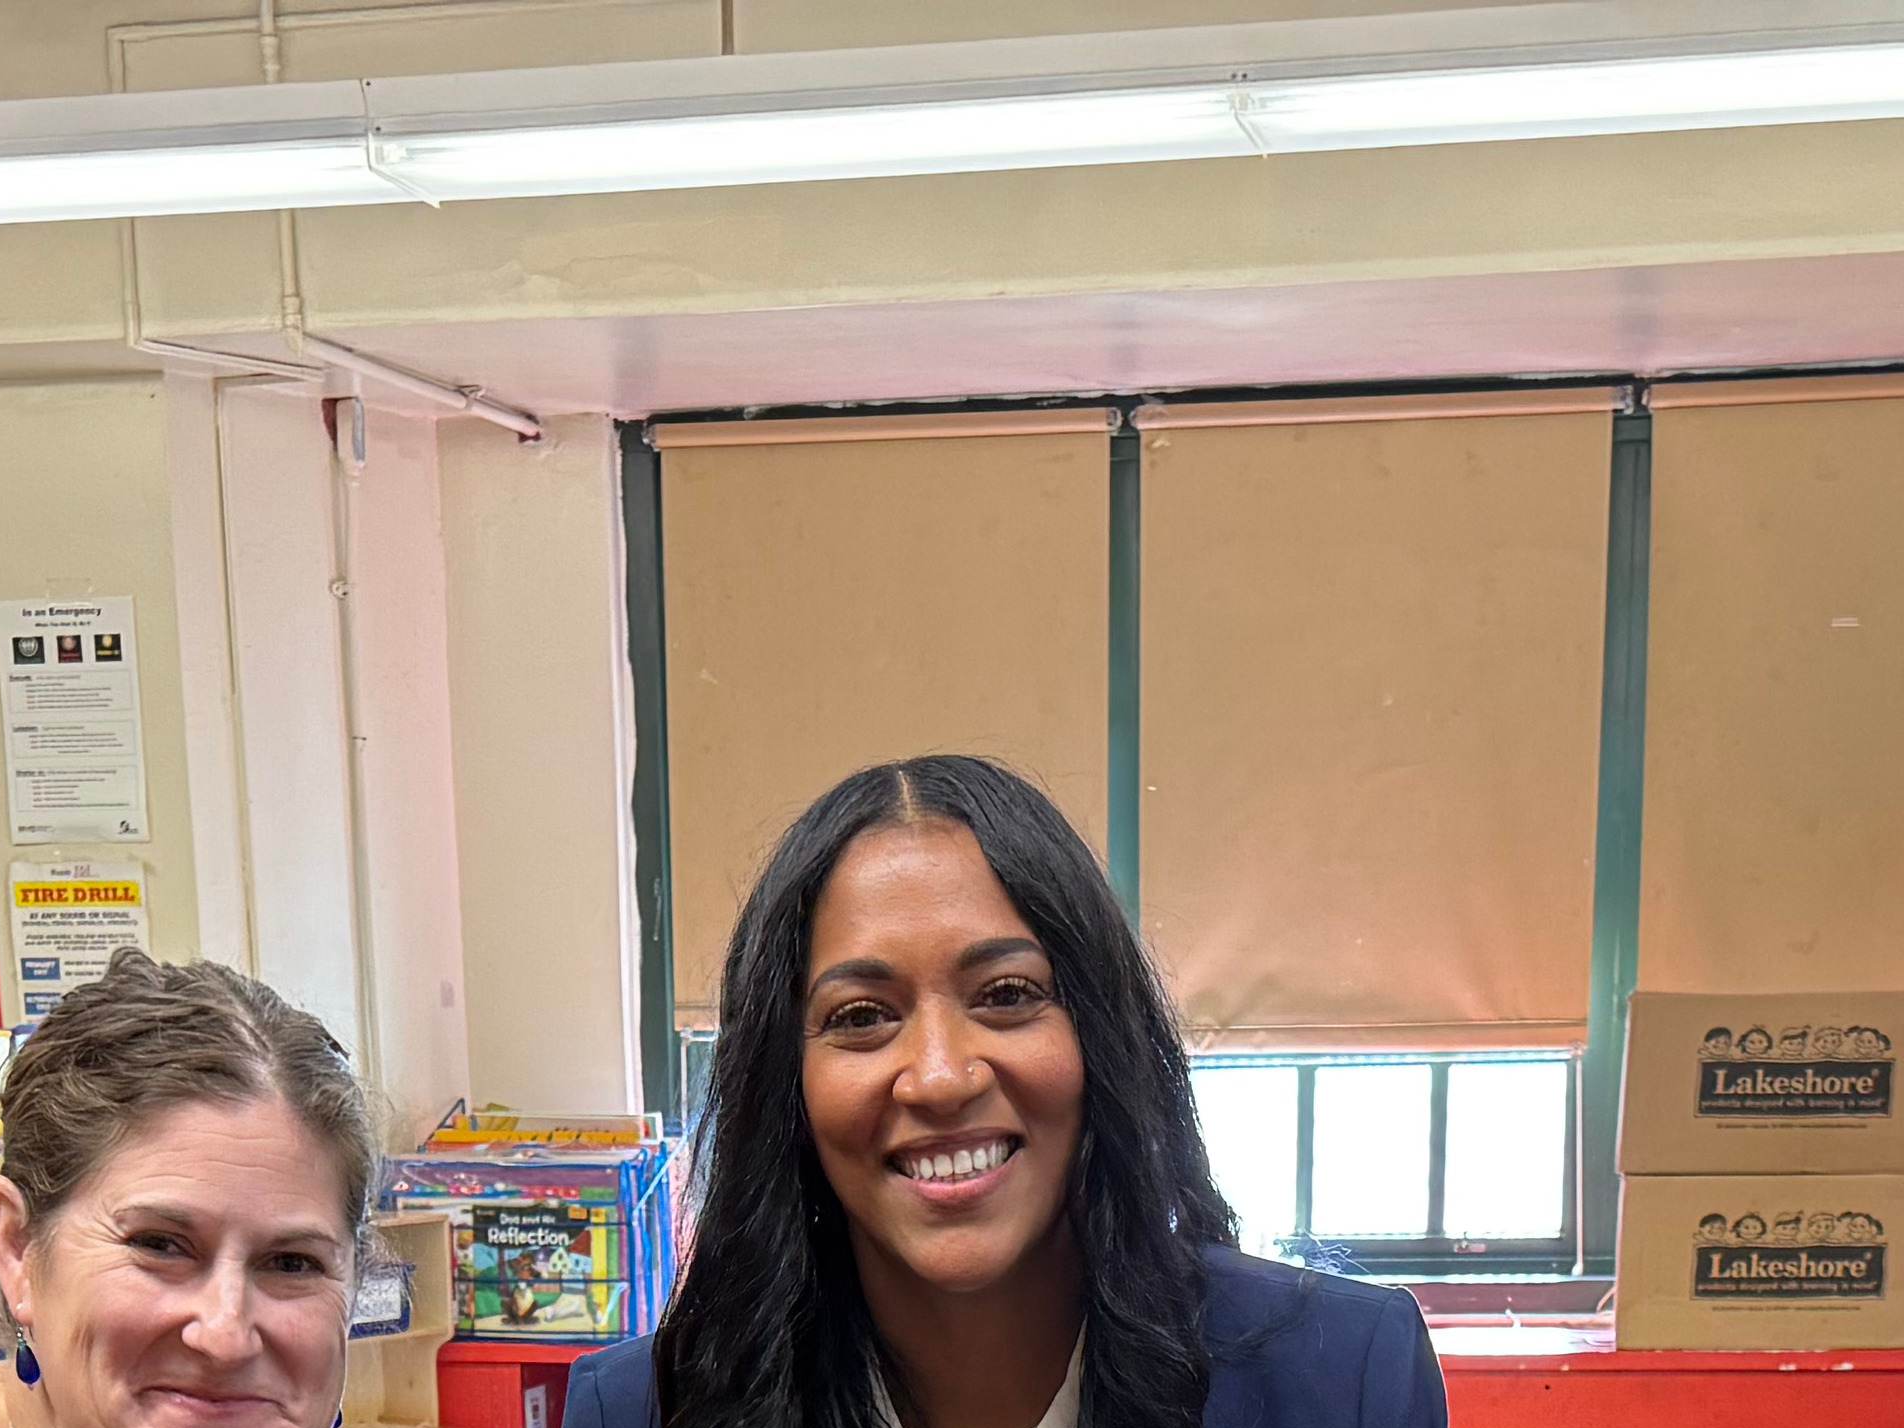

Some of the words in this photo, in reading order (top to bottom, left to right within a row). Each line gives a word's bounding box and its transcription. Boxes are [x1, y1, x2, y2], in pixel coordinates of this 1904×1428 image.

[49, 606, 102, 617] Emergency
[21, 887, 69, 903] FIRE
[73, 886, 135, 902] DRILL
[1713, 1068, 1875, 1095] Lakeshore
[487, 1226, 569, 1246] Reflection
[1708, 1251, 1868, 1279] Lakeshore
